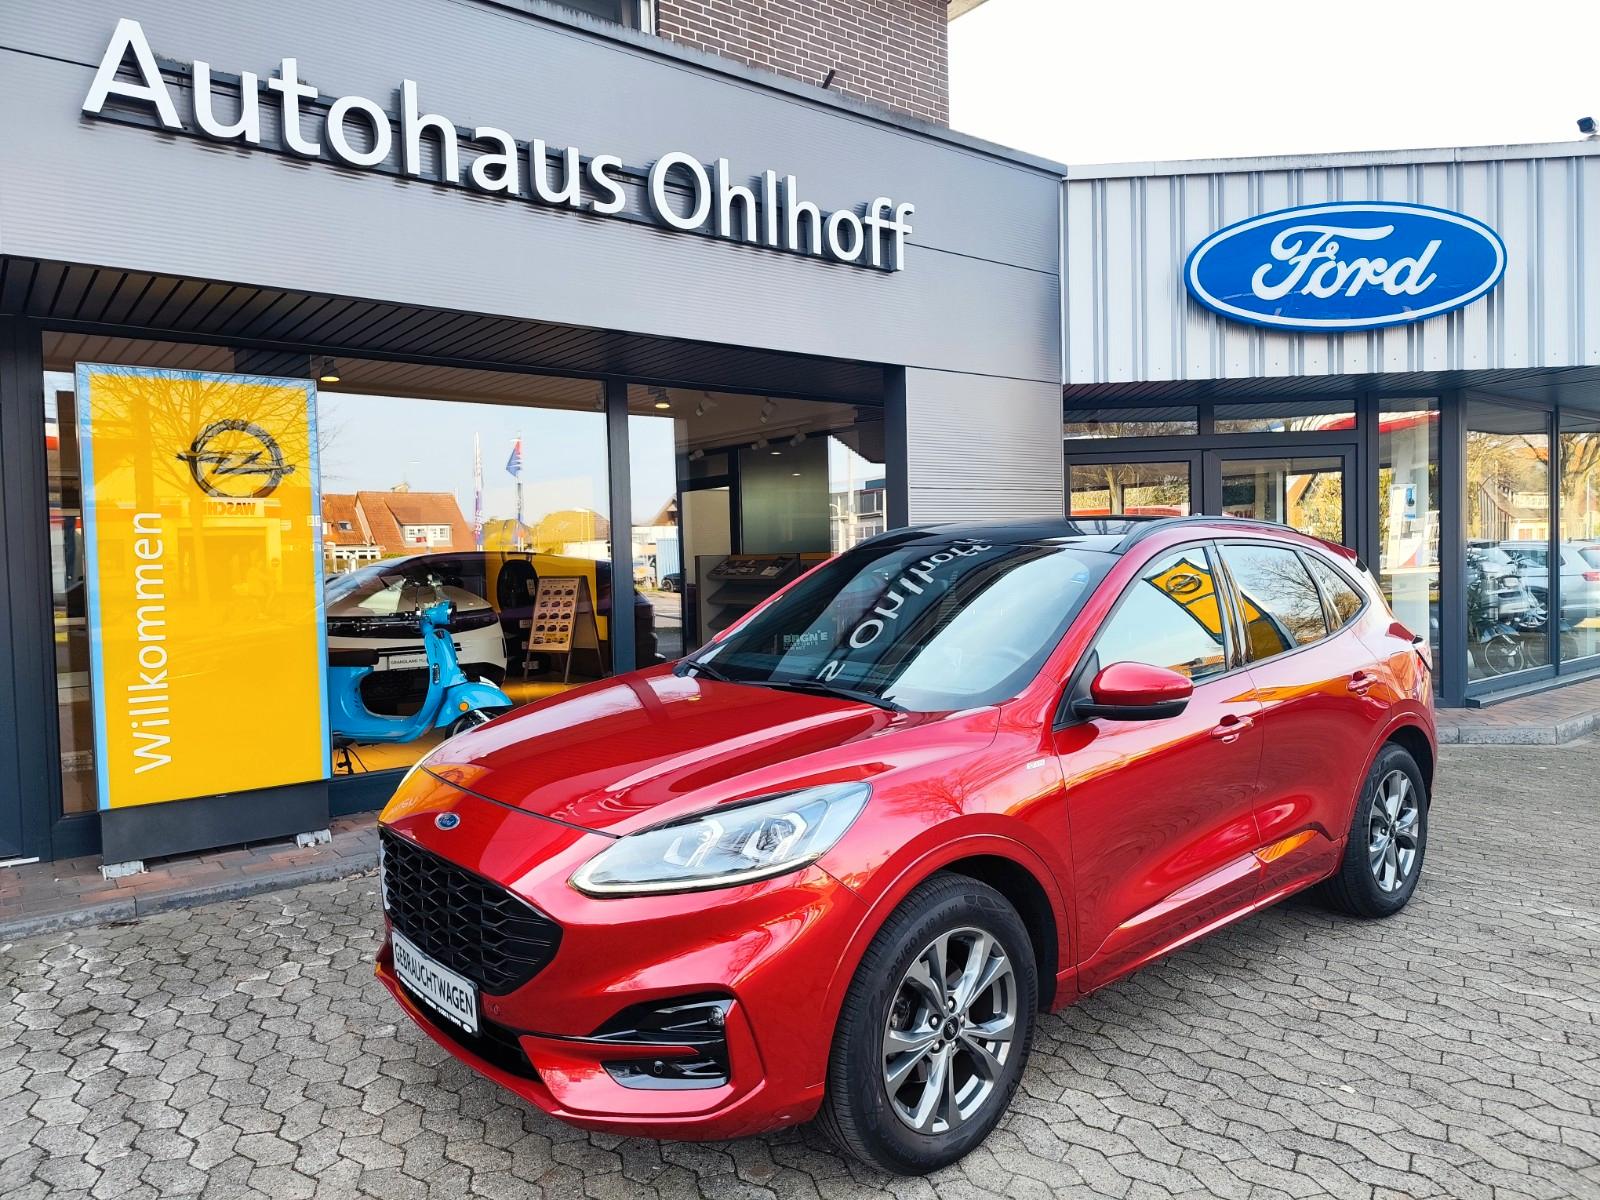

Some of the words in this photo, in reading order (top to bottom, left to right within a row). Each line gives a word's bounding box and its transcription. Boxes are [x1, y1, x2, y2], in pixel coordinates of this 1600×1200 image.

[81, 17, 627, 215] Autohaus
[648, 151, 915, 271] Ohlhoff
[1251, 224, 1443, 301] Ford
[128, 512, 172, 775] Willkommen
[394, 942, 474, 1018] GEBRAUCHTWAGEN
